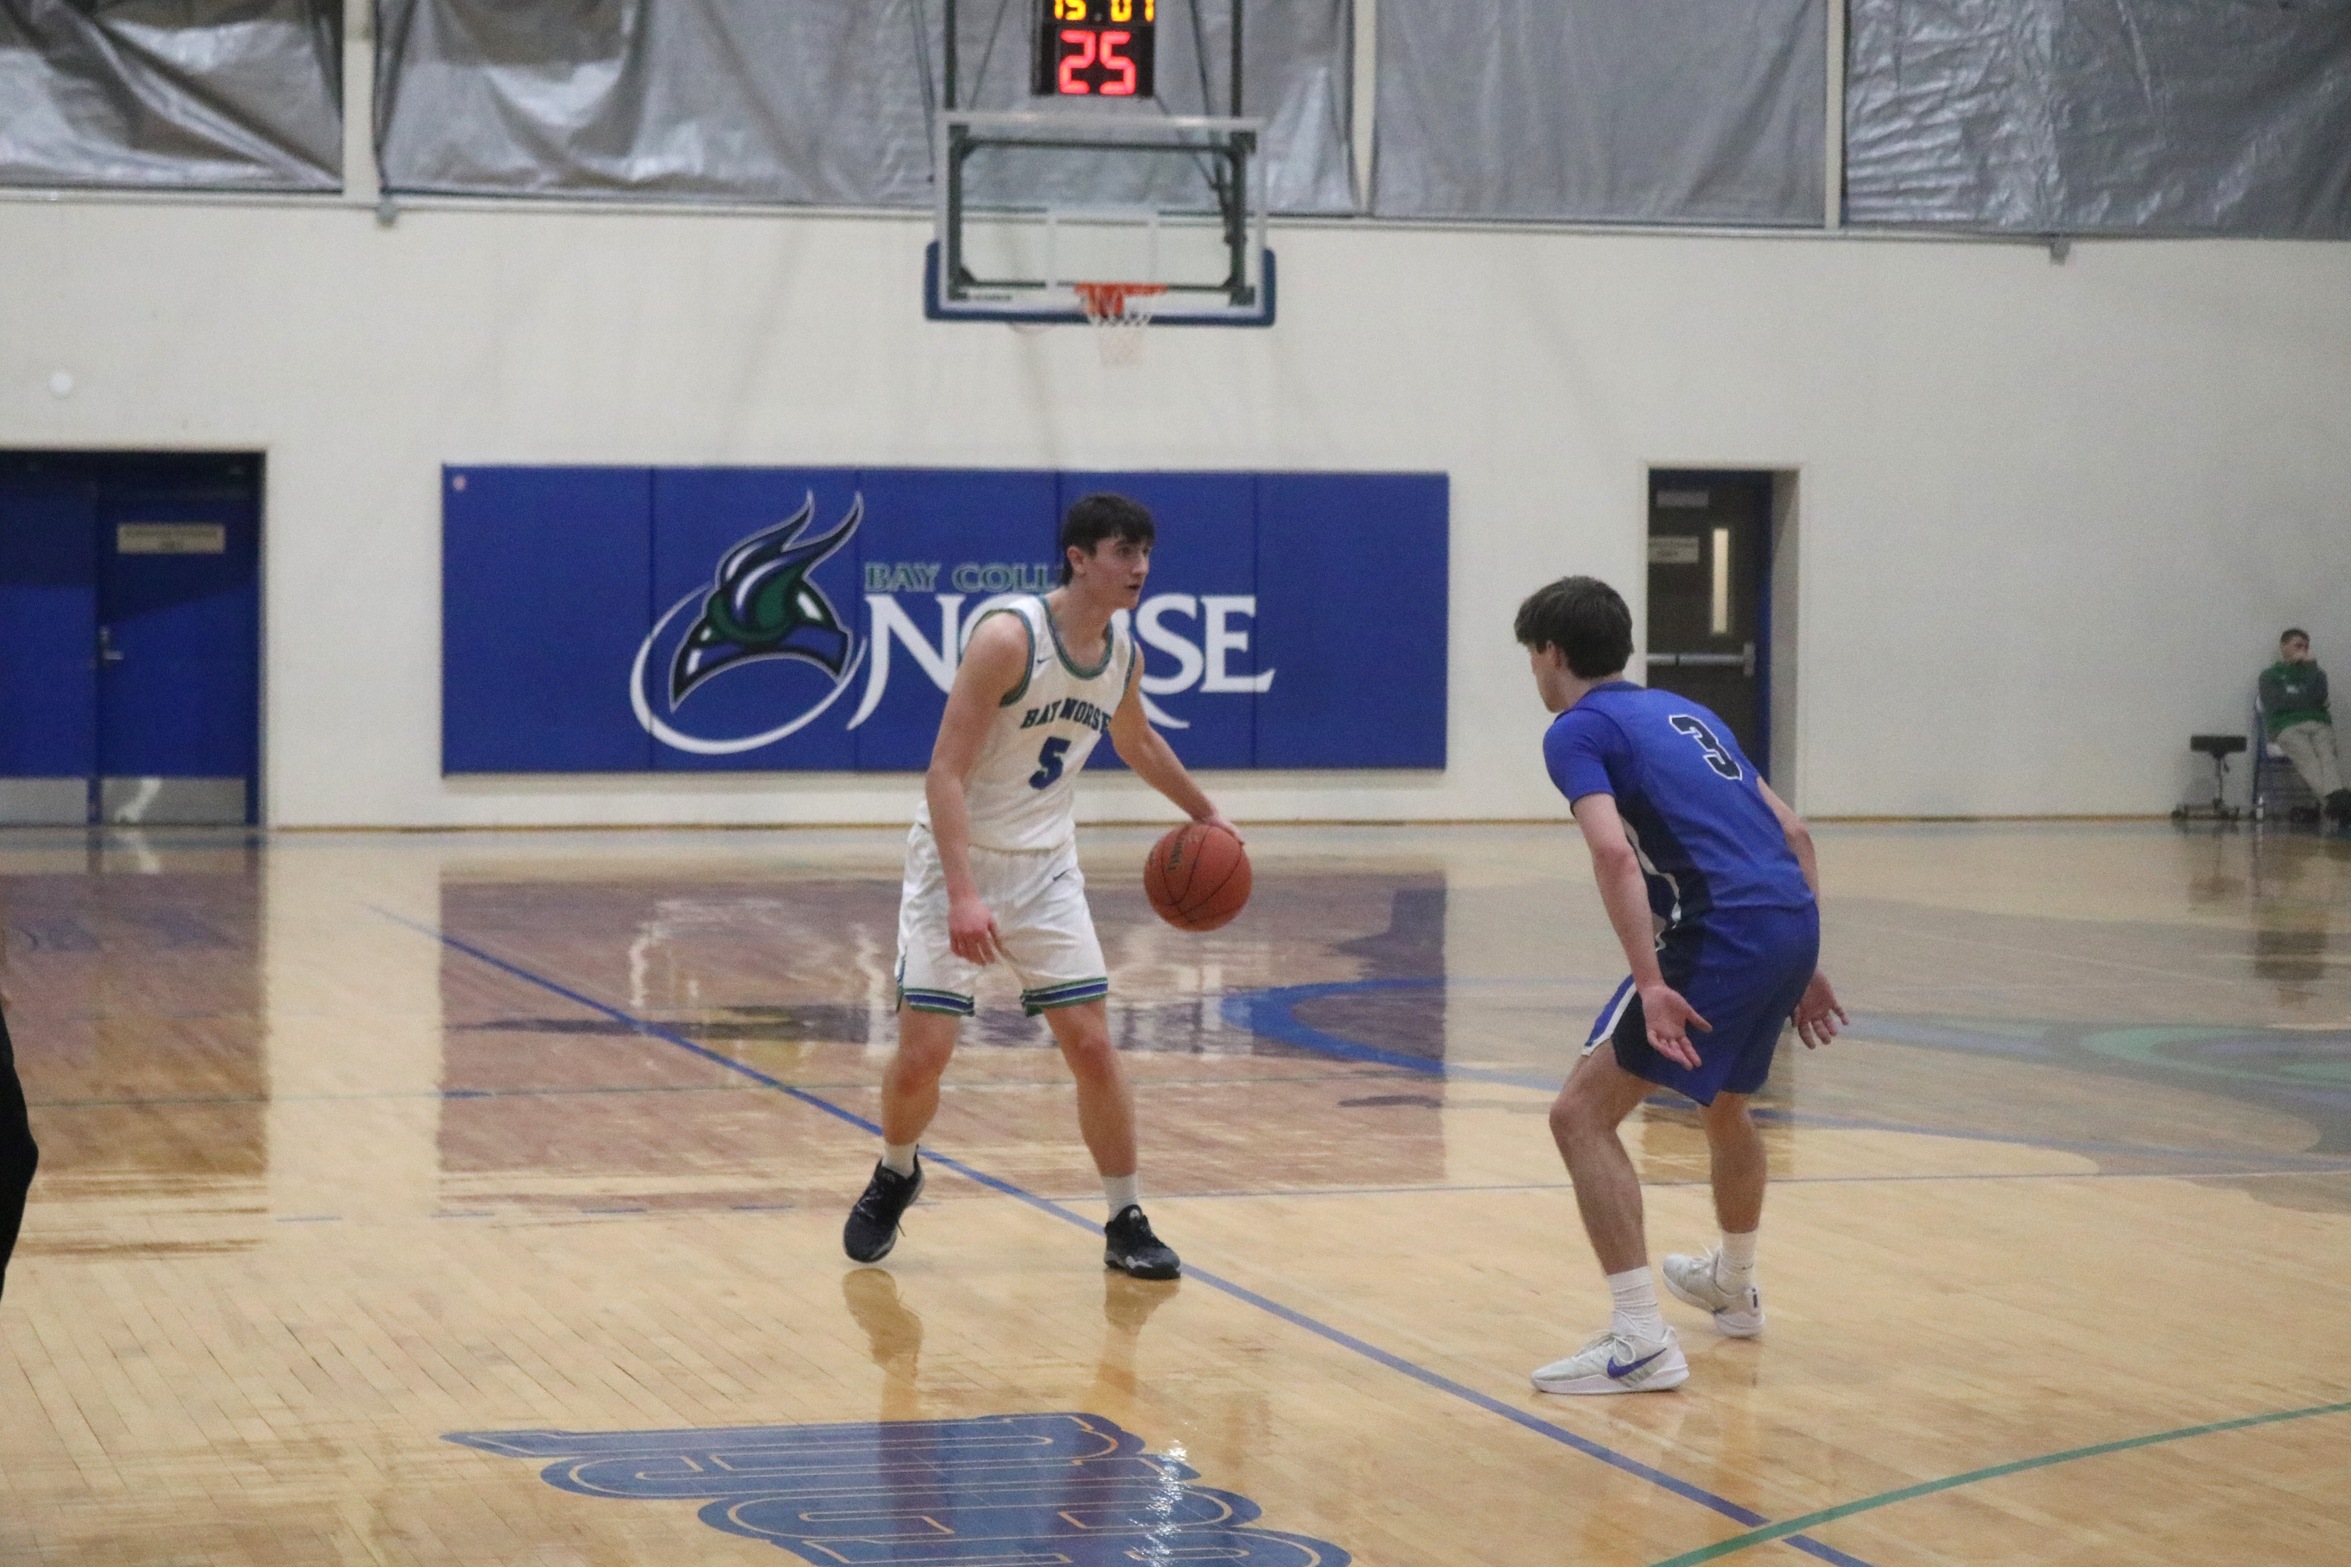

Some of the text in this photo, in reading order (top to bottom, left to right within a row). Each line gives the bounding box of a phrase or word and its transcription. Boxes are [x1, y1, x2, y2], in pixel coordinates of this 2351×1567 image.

[1058, 29, 1136, 95] 25
[864, 562, 941, 592] BAY
[1020, 700, 1062, 729] BAY
[1028, 736, 1072, 790] 5
[1669, 714, 1742, 781] 3
